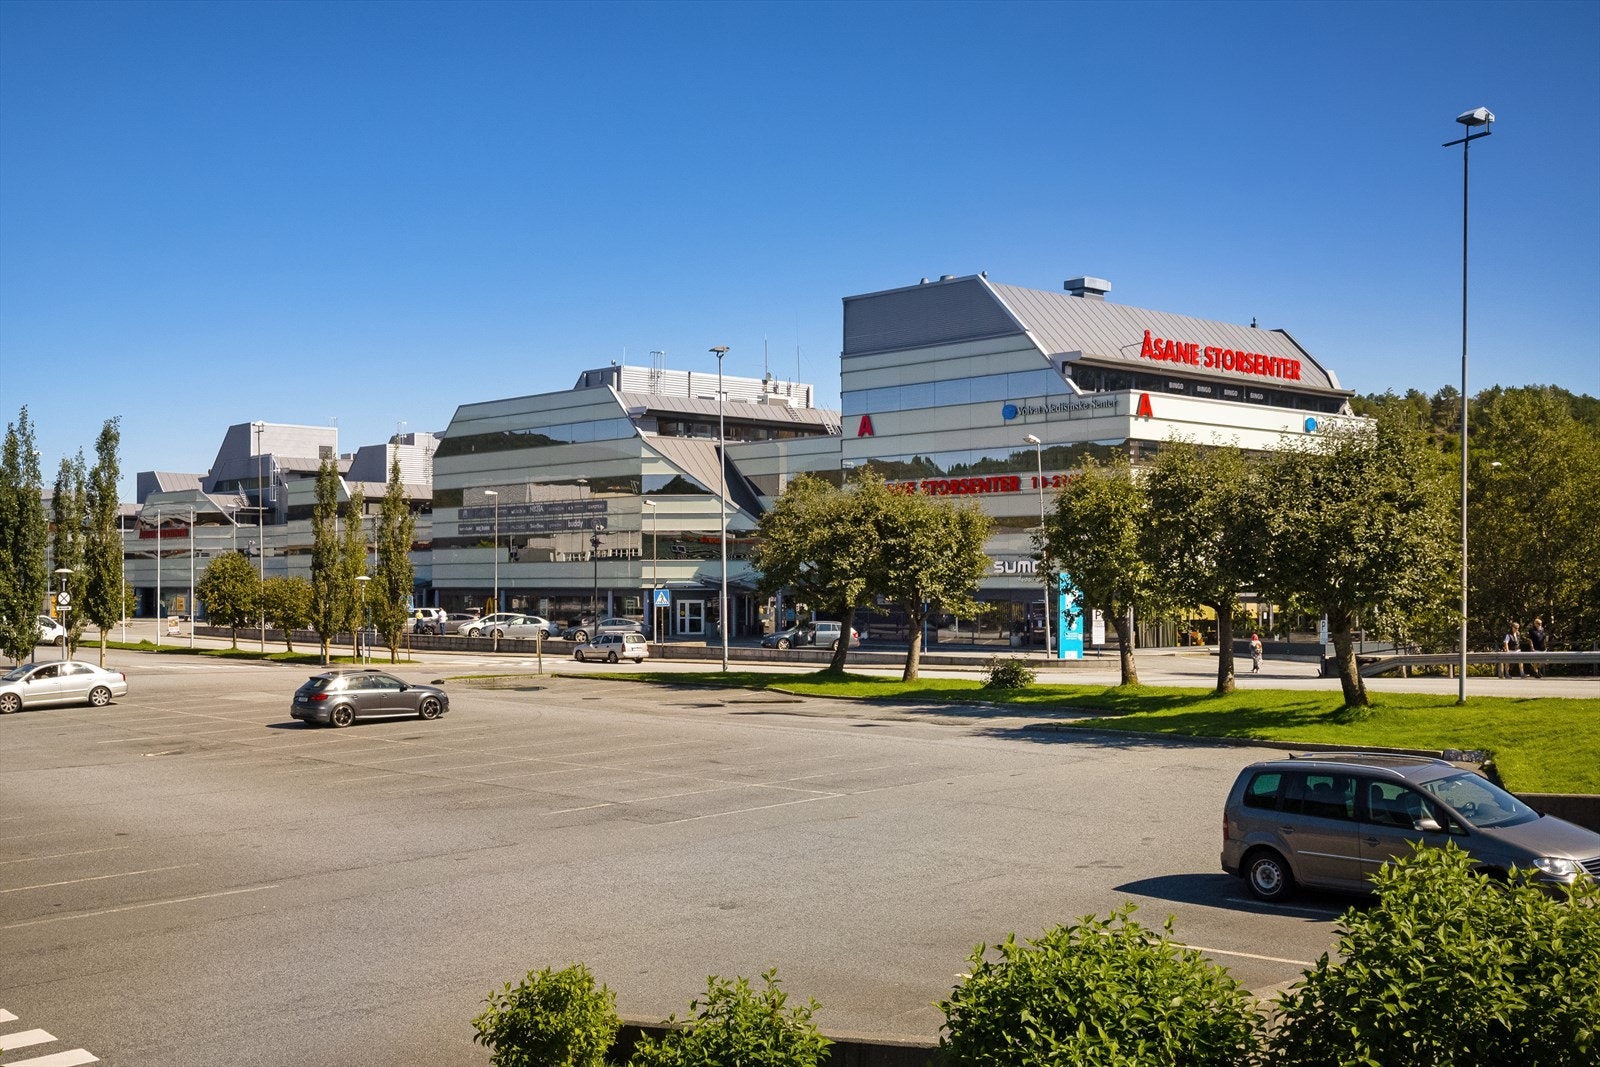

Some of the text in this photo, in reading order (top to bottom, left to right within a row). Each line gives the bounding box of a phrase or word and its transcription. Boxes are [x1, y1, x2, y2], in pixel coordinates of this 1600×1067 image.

[1140, 329, 1302, 381] ÅSANE STORSENTER
[1168, 381, 1184, 390] BINGO
[1196, 385, 1212, 394] BINGO
[1223, 388, 1239, 397] BINGO
[1249, 392, 1264, 400] BINGO
[1044, 400, 1089, 414] Medisinske
[1090, 399, 1119, 411] Senter
[1135, 392, 1154, 419] A
[857, 414, 875, 439] A
[920, 475, 1021, 496] STORSENTER
